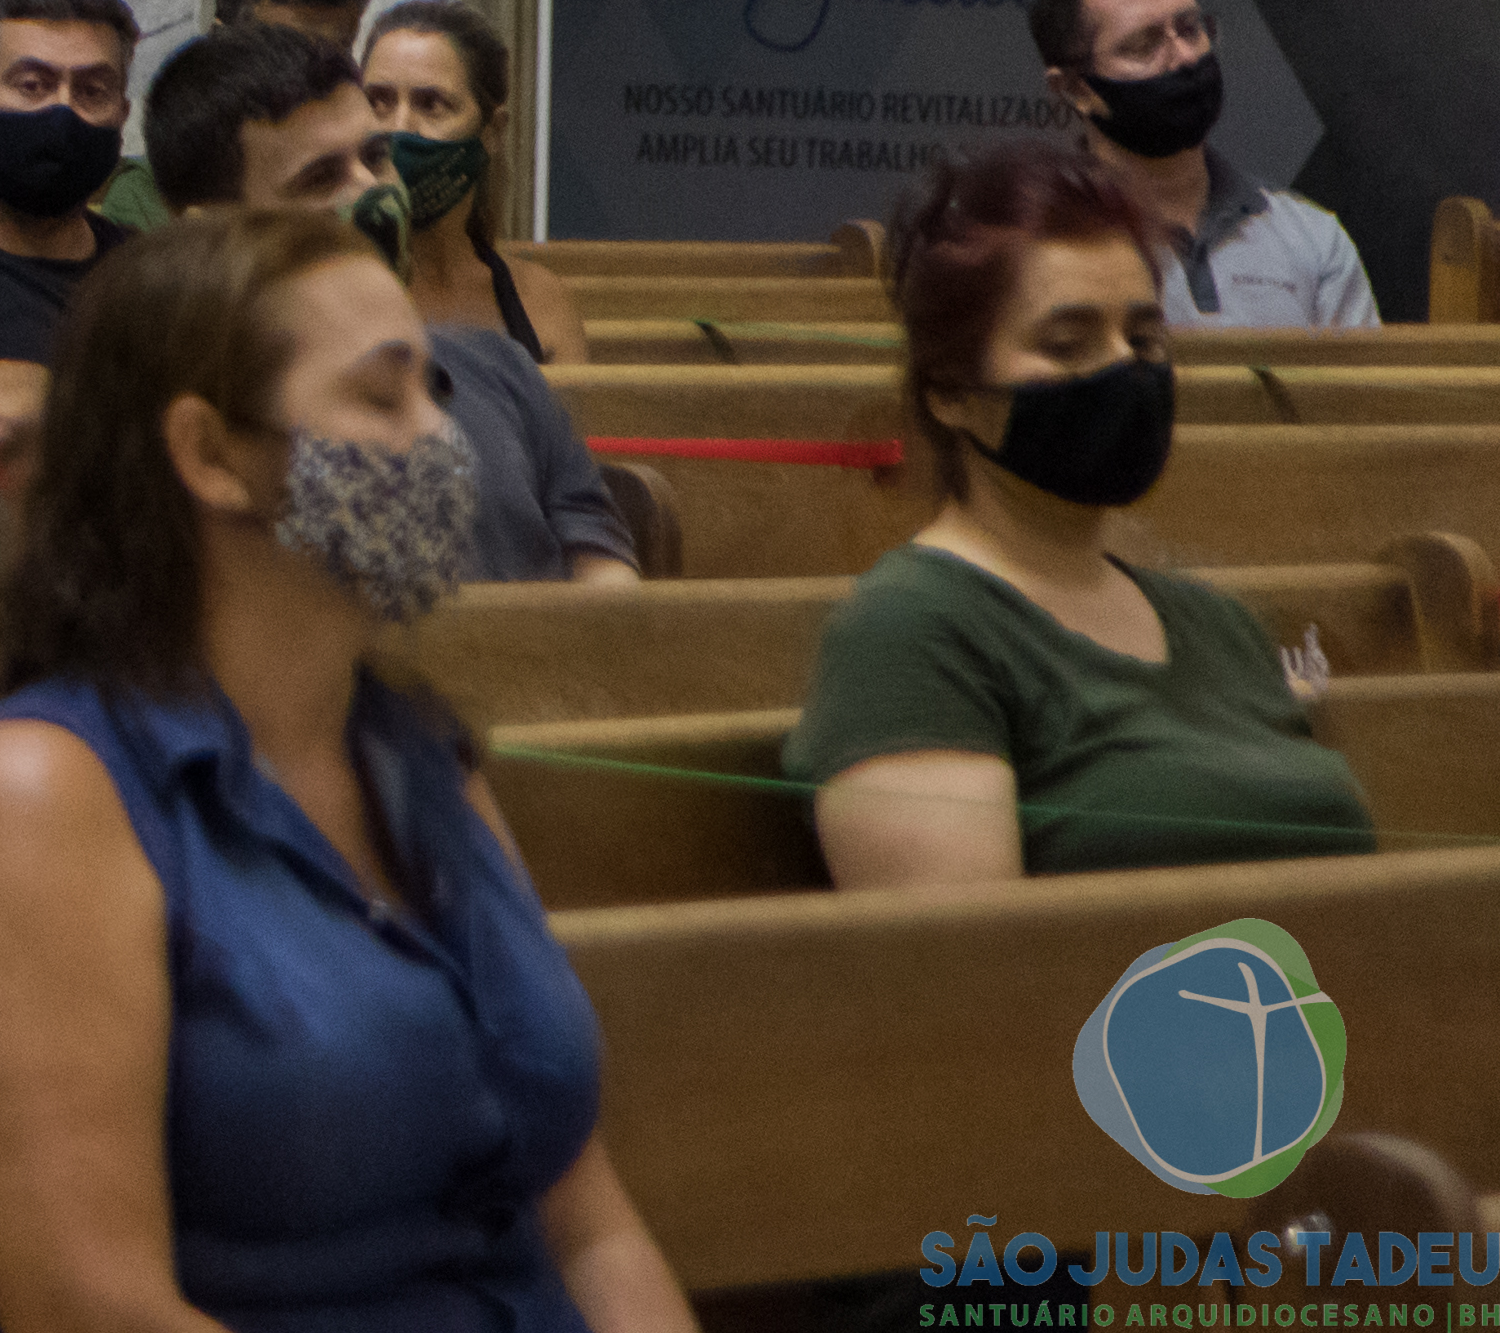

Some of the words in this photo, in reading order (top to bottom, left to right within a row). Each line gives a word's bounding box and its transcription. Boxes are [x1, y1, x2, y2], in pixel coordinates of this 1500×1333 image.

[624, 84, 717, 117] NOSSO
[718, 85, 876, 124] SANTUÁRIO
[882, 94, 1074, 130] REVITALIZADO
[636, 132, 740, 168] AMPLIA
[749, 136, 799, 168] SEU
